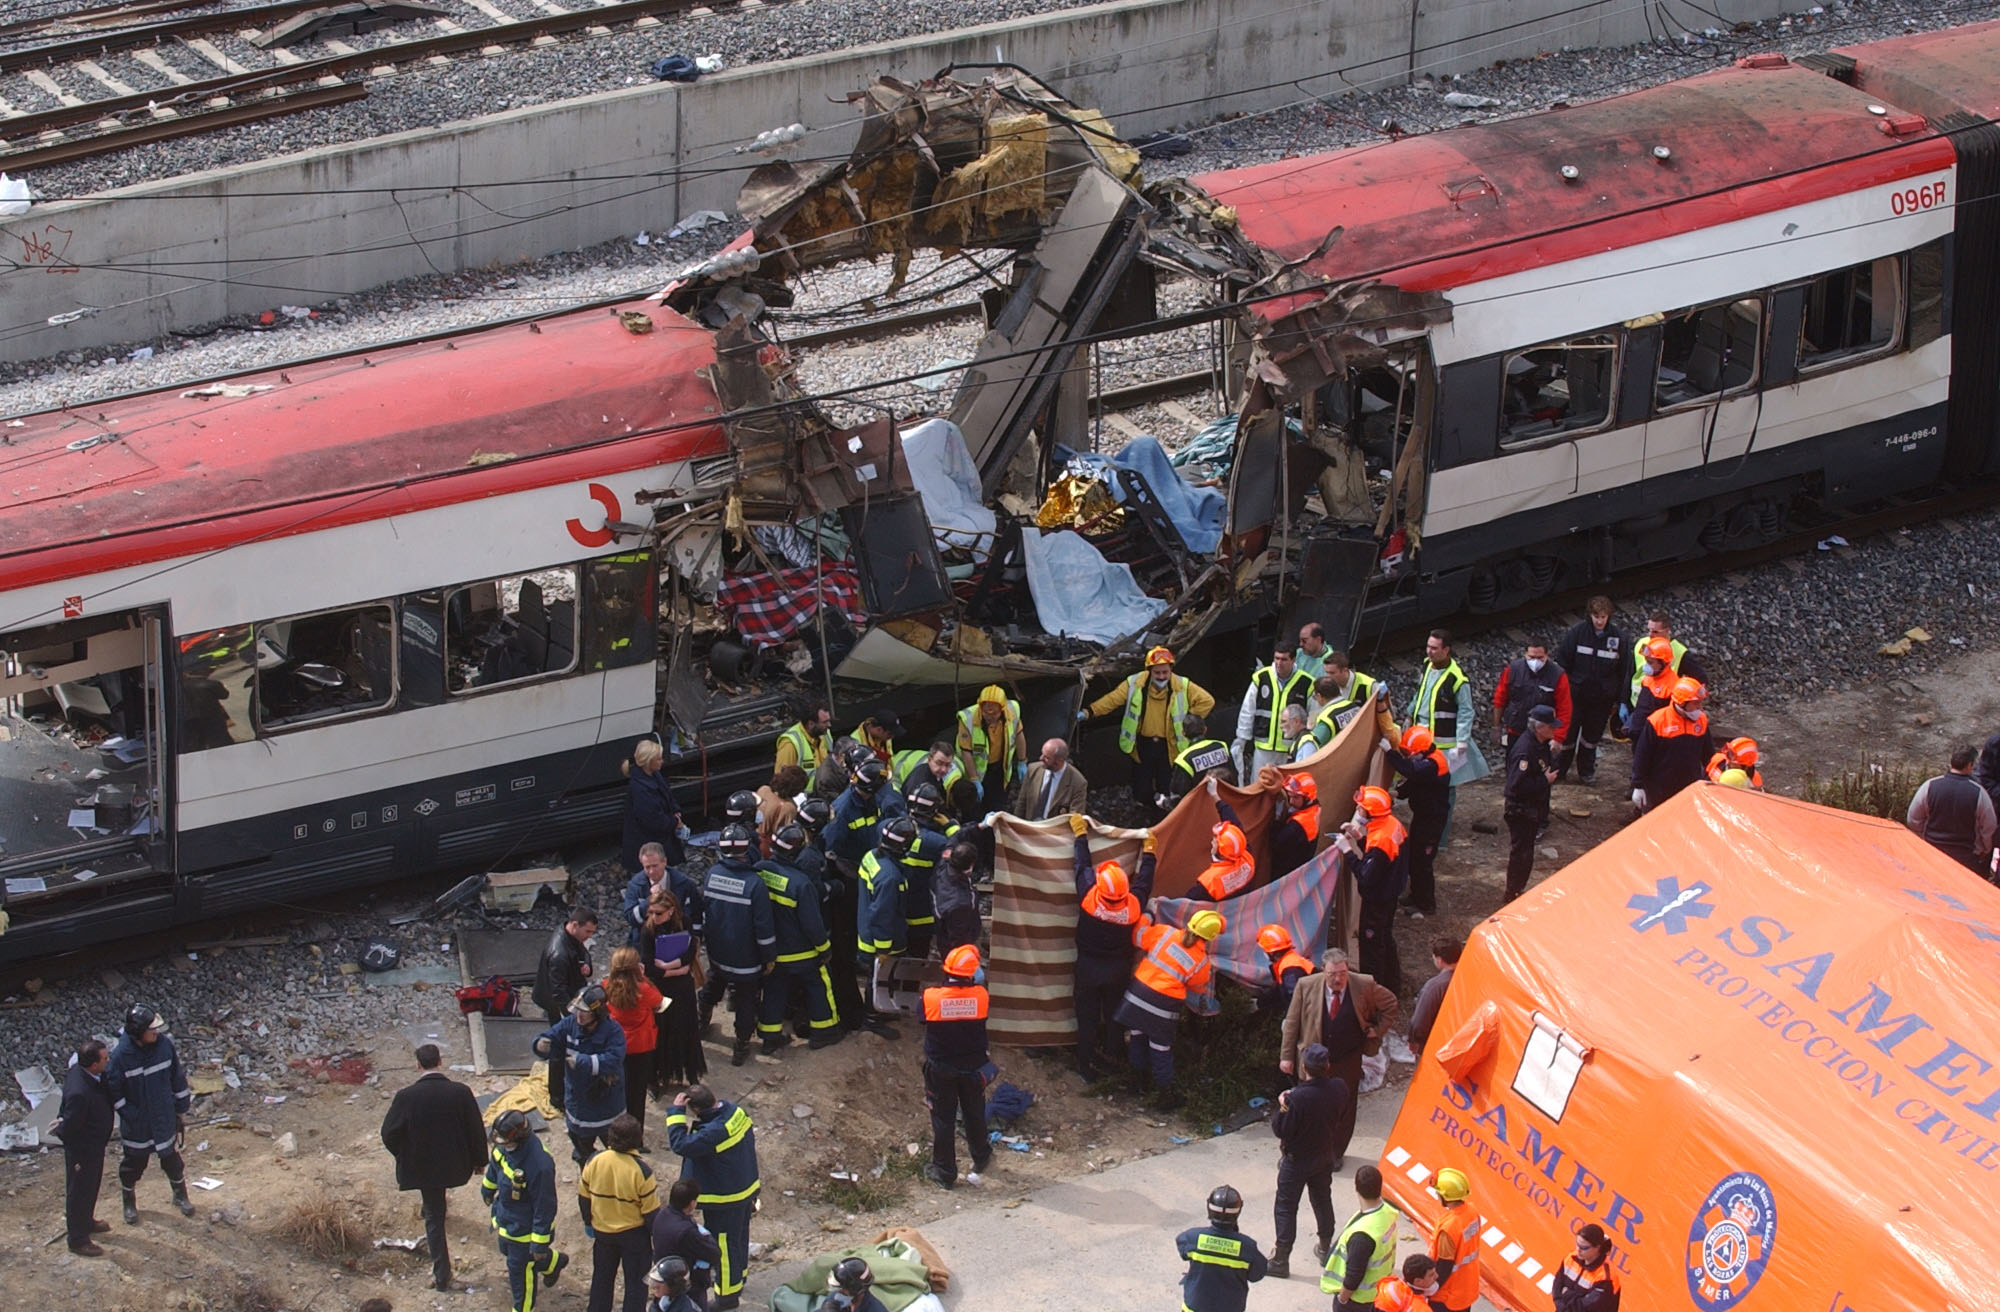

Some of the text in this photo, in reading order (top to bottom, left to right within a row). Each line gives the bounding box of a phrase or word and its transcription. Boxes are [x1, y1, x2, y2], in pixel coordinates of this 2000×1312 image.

[1891, 181, 1946, 216] 096R
[1194, 749, 1228, 771] POLICIA
[1673, 947, 2000, 1171] PROTECCION CIVIL
[1442, 1077, 1645, 1244] SAMER
[1429, 1106, 1632, 1275] PROTECCION CIL
[1707, 1224, 1746, 1268] PROTECCION CIVIL
[1694, 1267, 1730, 1301] SAMER
